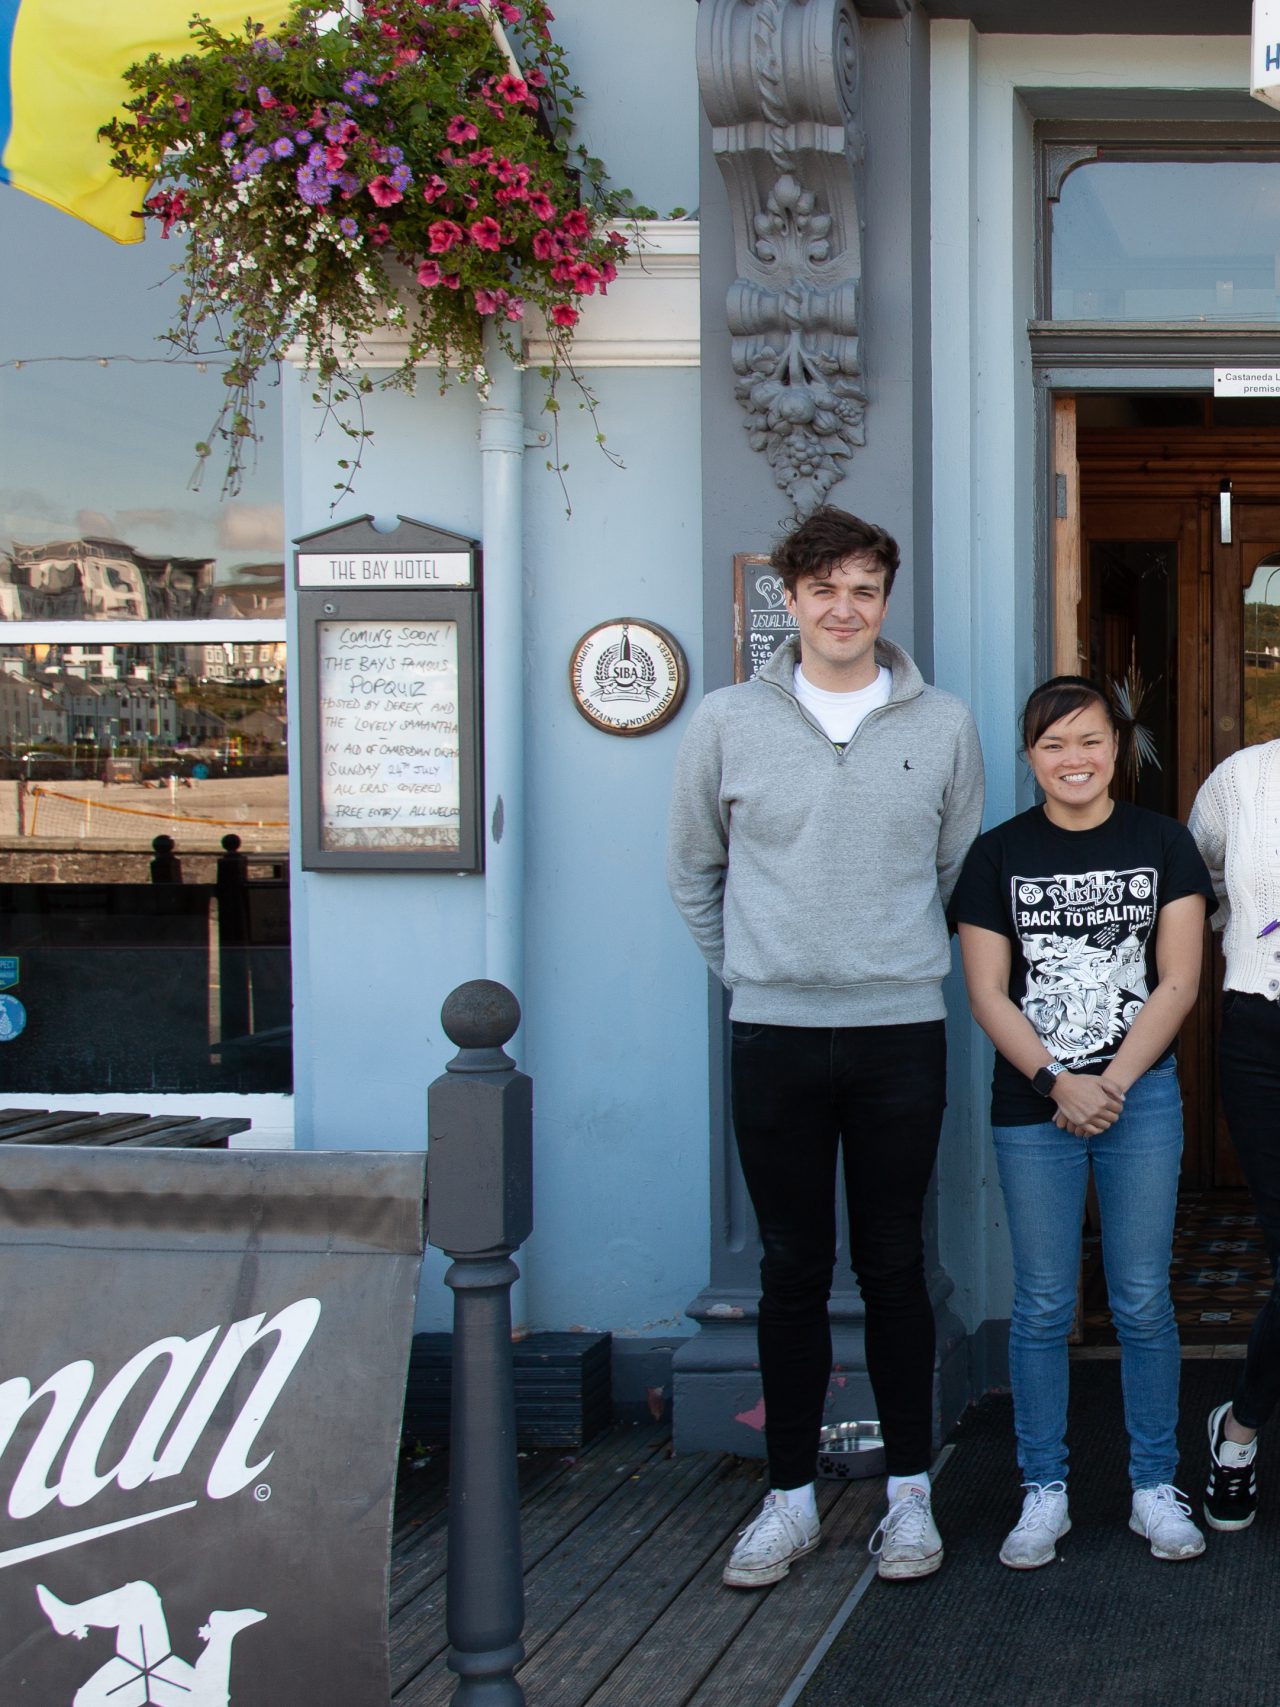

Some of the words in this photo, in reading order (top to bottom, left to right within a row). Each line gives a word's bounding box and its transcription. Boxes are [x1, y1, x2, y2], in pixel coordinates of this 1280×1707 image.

[1225, 373, 1273, 381] Castaneda
[329, 560, 357, 580] THE
[362, 560, 389, 580] BAY
[395, 559, 440, 579] HOTEL
[752, 614, 781, 628] USUAL
[782, 614, 800, 627] HOU
[340, 627, 393, 645] COMING
[398, 627, 440, 644] SOON
[325, 656, 355, 671] THE
[359, 656, 396, 673] BAY'S
[400, 657, 449, 672] FAMOUS
[574, 641, 594, 695] SUPPORTING
[656, 642, 677, 682] BREWERS
[613, 667, 638, 679] SIBA
[320, 698, 361, 710] HOSTED
[364, 700, 381, 711] BY
[384, 700, 423, 715] DEREK
[430, 702, 456, 714] AND
[582, 698, 621, 726] BRITAIN'S
[625, 687, 675, 727] INDEPENDENT
[325, 716, 346, 728] THE
[400, 720, 458, 735] SAMANTHA
[324, 743, 339, 753] IN
[366, 743, 378, 753] OF
[328, 762, 381, 779] SUNDAY
[413, 765, 441, 777] JULY
[334, 784, 357, 795] ALL
[359, 784, 388, 793] ERAS
[397, 783, 442, 793] COVERED
[336, 805, 365, 819] FREE
[409, 805, 426, 816] ALL
[1021, 910, 1061, 927] BACK
[1064, 911, 1084, 926] TO
